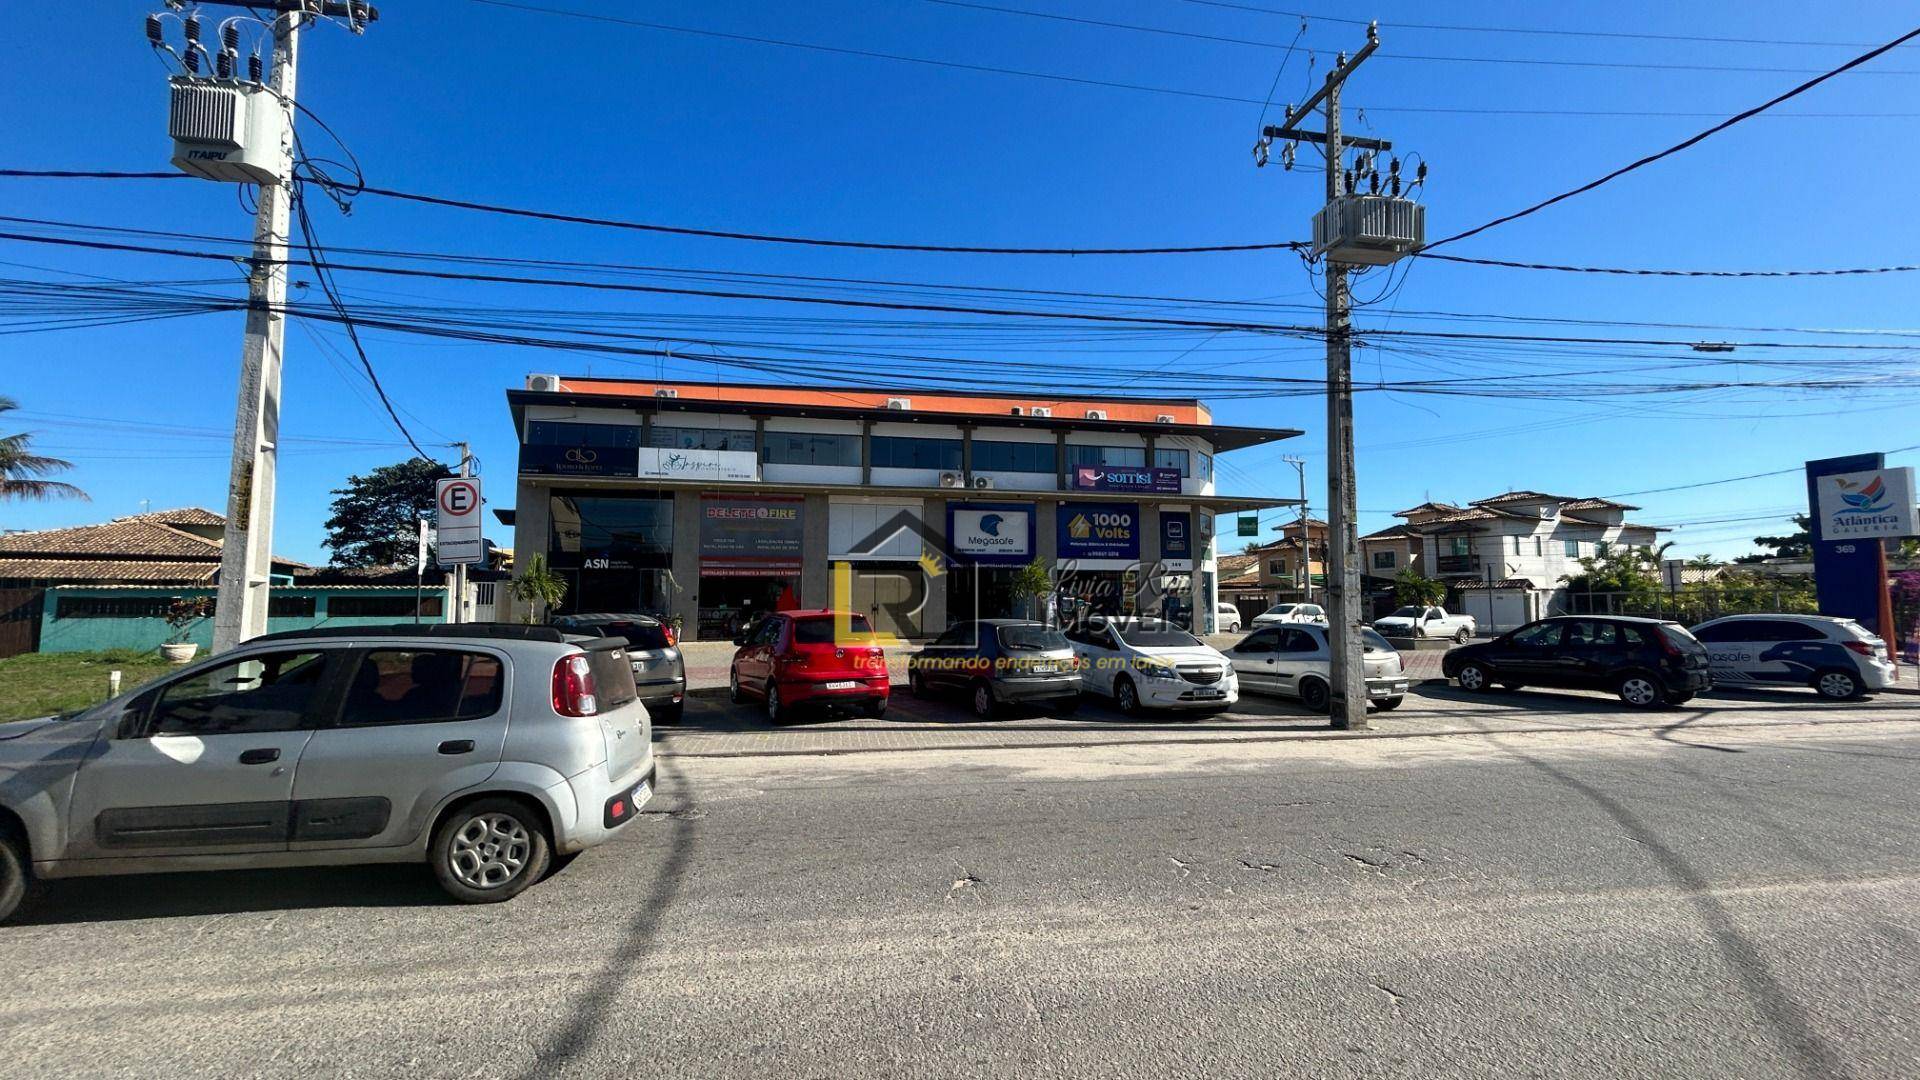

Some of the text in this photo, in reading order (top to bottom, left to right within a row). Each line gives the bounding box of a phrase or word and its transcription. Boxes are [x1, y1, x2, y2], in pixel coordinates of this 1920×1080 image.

[188, 150, 227, 160] ITAIPU
[451, 487, 467, 510] E
[706, 507, 797, 519] DELETE FIRE
[1092, 513, 1131, 527] 1000
[1833, 514, 1899, 527] Atlântica
[1095, 527, 1131, 539] Volts
[1833, 524, 1899, 534] GALERIA
[968, 536, 1014, 546] Megasafe
[1835, 545, 1856, 554] 369
[584, 559, 609, 569] ASN
